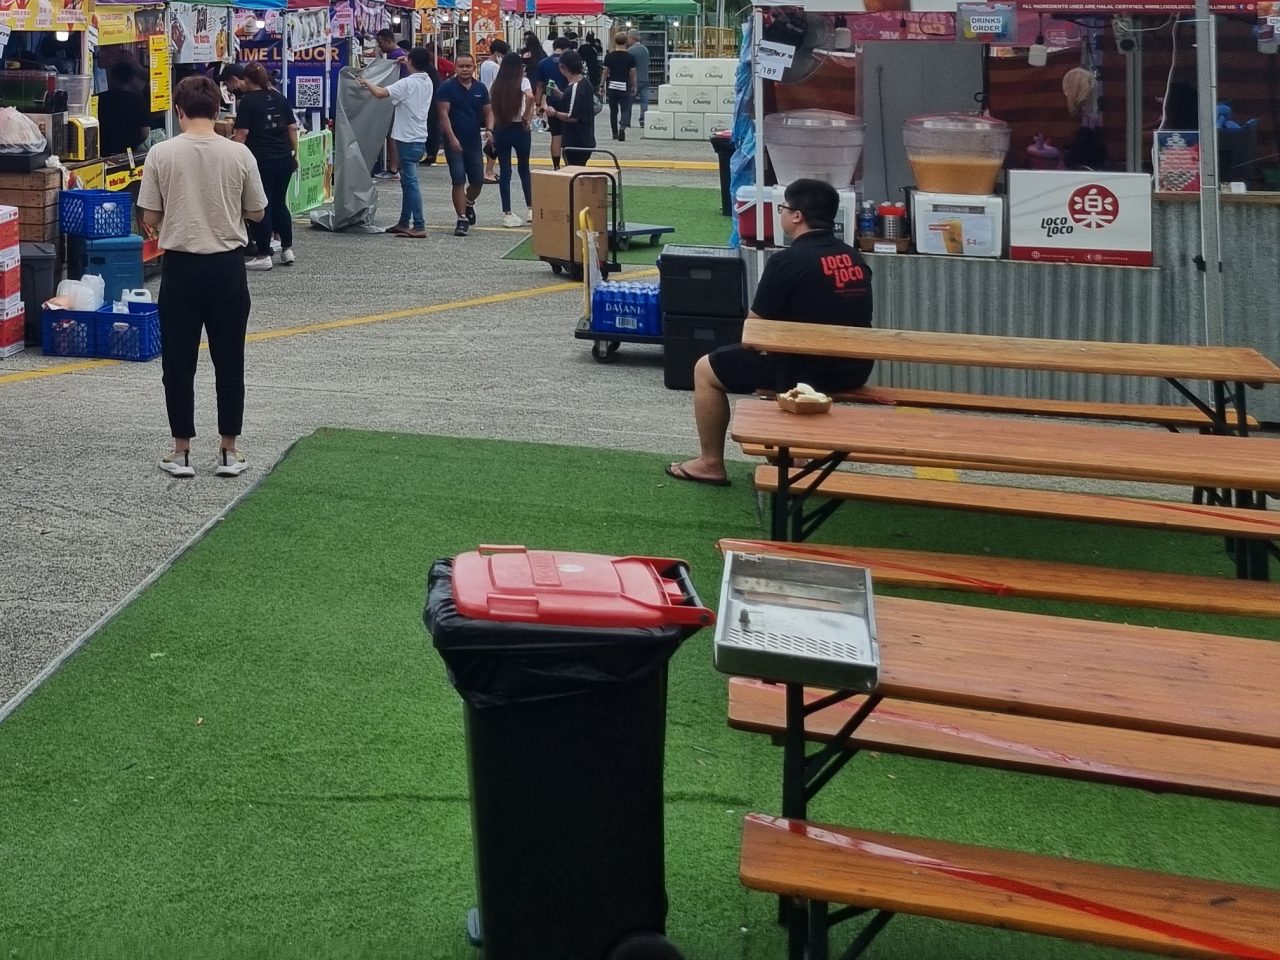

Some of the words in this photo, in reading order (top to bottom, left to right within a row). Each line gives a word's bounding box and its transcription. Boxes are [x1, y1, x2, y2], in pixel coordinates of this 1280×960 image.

[239, 48, 269, 60] IME
[762, 66, 777, 75] 189
[650, 124, 668, 132] Chang
[1041, 217, 1068, 229] LOCO
[1046, 225, 1074, 238] LOCO
[820, 253, 853, 275] LOCO
[834, 266, 864, 288] LOCO
